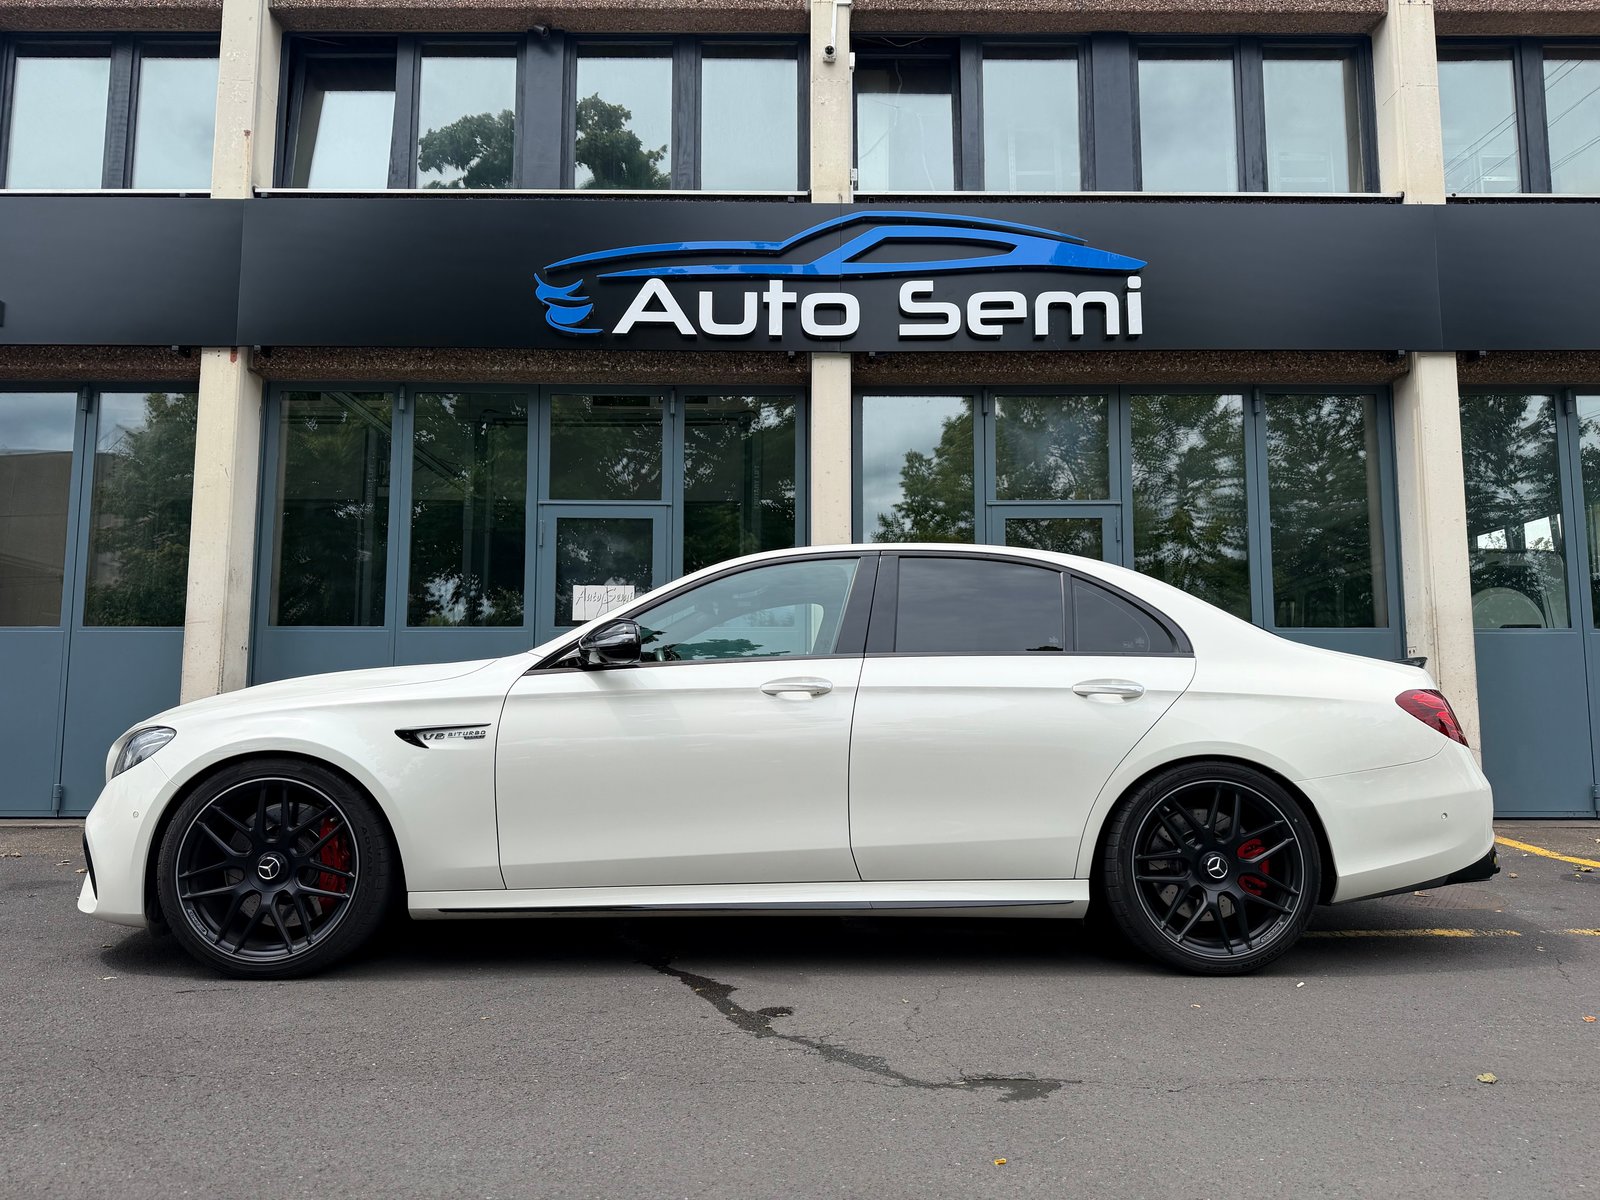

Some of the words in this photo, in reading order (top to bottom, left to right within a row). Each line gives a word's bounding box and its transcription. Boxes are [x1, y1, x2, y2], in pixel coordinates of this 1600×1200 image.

[611, 277, 860, 337] Auto
[898, 275, 1143, 337] Semi
[422, 732, 446, 740] V8
[360, 826, 373, 875] ADVAN
[1242, 946, 1282, 969] ADVAN
